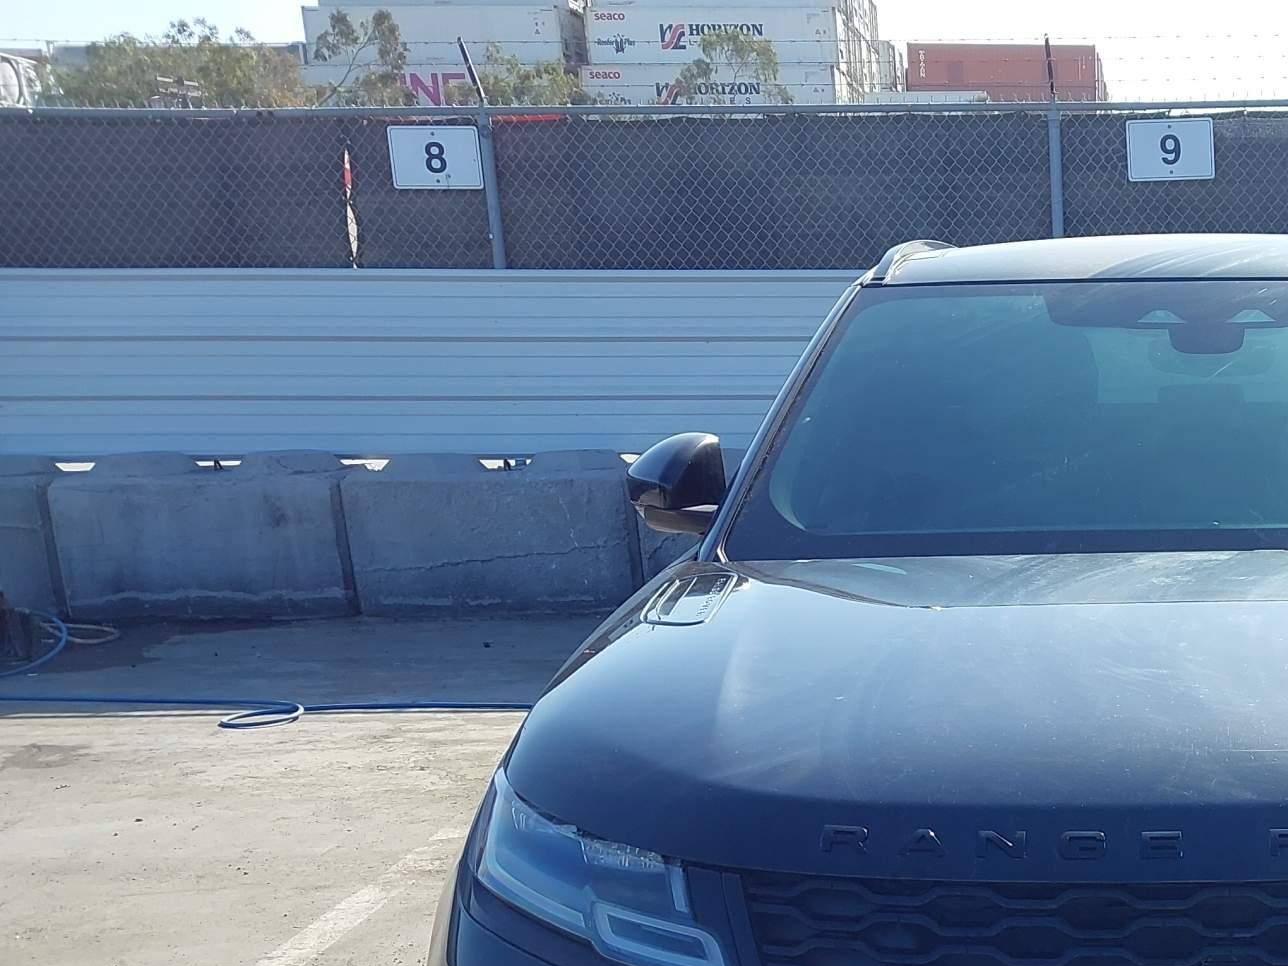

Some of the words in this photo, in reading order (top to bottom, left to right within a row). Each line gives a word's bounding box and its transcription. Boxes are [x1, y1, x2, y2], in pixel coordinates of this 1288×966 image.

[594, 12, 625, 21] seaco
[589, 71, 621, 80] seaco
[425, 142, 447, 173] 8
[1160, 134, 1181, 165] 9
[819, 824, 1184, 861] RANGE
